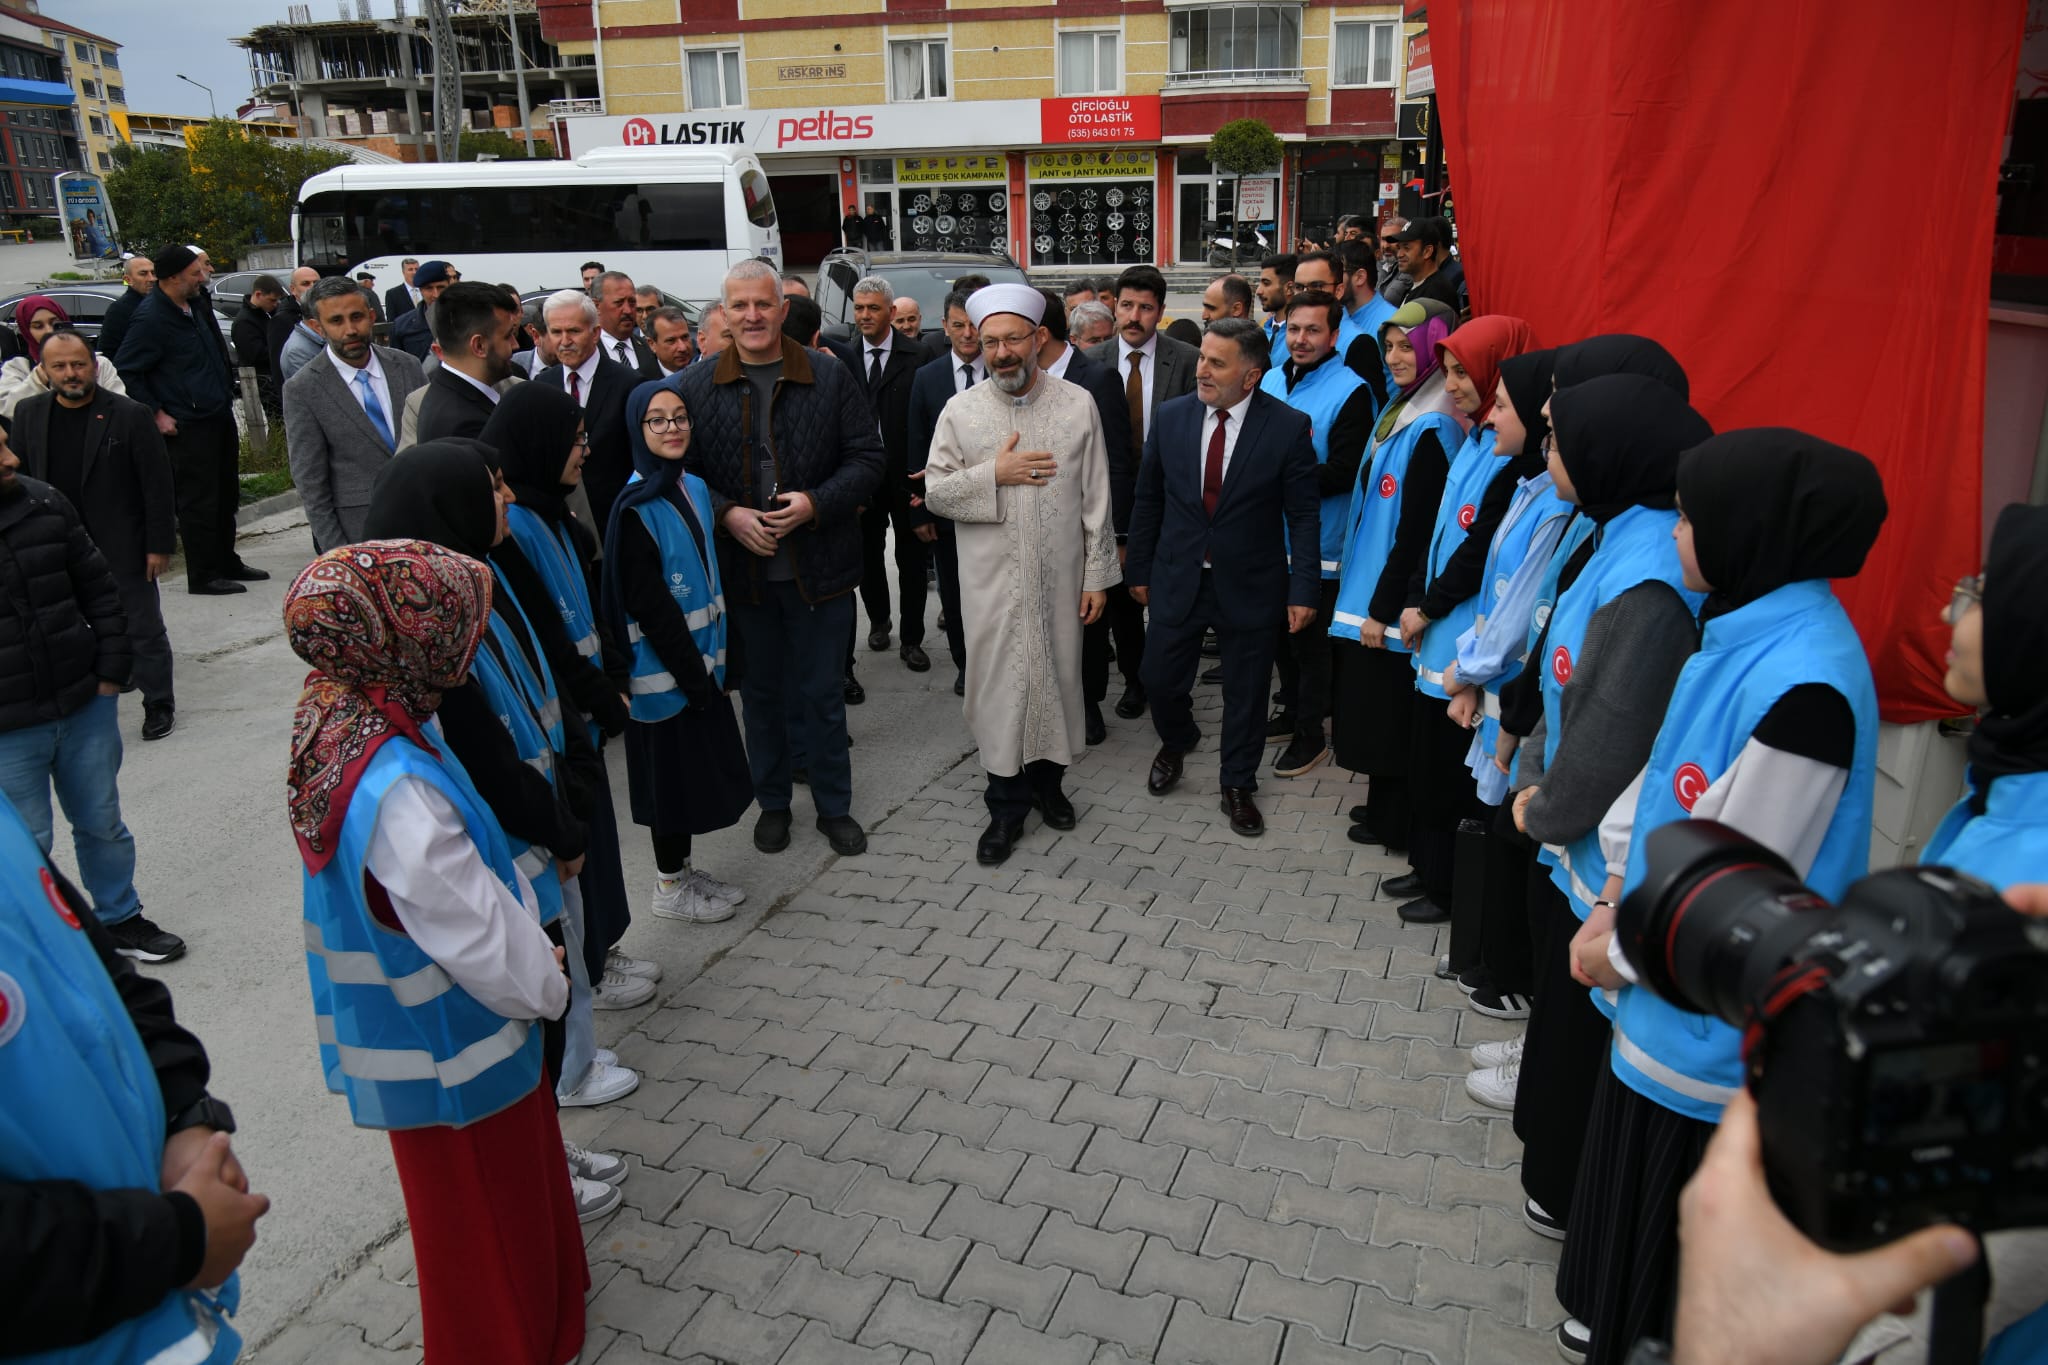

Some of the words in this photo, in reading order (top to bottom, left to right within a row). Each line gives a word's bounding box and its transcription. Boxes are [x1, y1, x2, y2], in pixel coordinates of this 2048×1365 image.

[780, 67, 823, 79] KASKAR
[1072, 99, 1129, 113] ÇİFCİOĞLU
[1069, 114, 1092, 124] OTO
[1094, 111, 1133, 123] LASTİK
[778, 110, 873, 148] petlas
[1068, 128, 1090, 140] (535)
[1092, 128, 1109, 137] 643
[1110, 127, 1121, 137] 01
[1124, 127, 1135, 137] 75
[900, 173, 940, 182] AKÜLERDE
[943, 172, 960, 182] ŞOK
[961, 171, 1005, 180] KAMPANYA
[1040, 169, 1060, 179] JANT
[1074, 168, 1095, 178] JANT
[1097, 167, 1147, 176] KAPAKLARI
